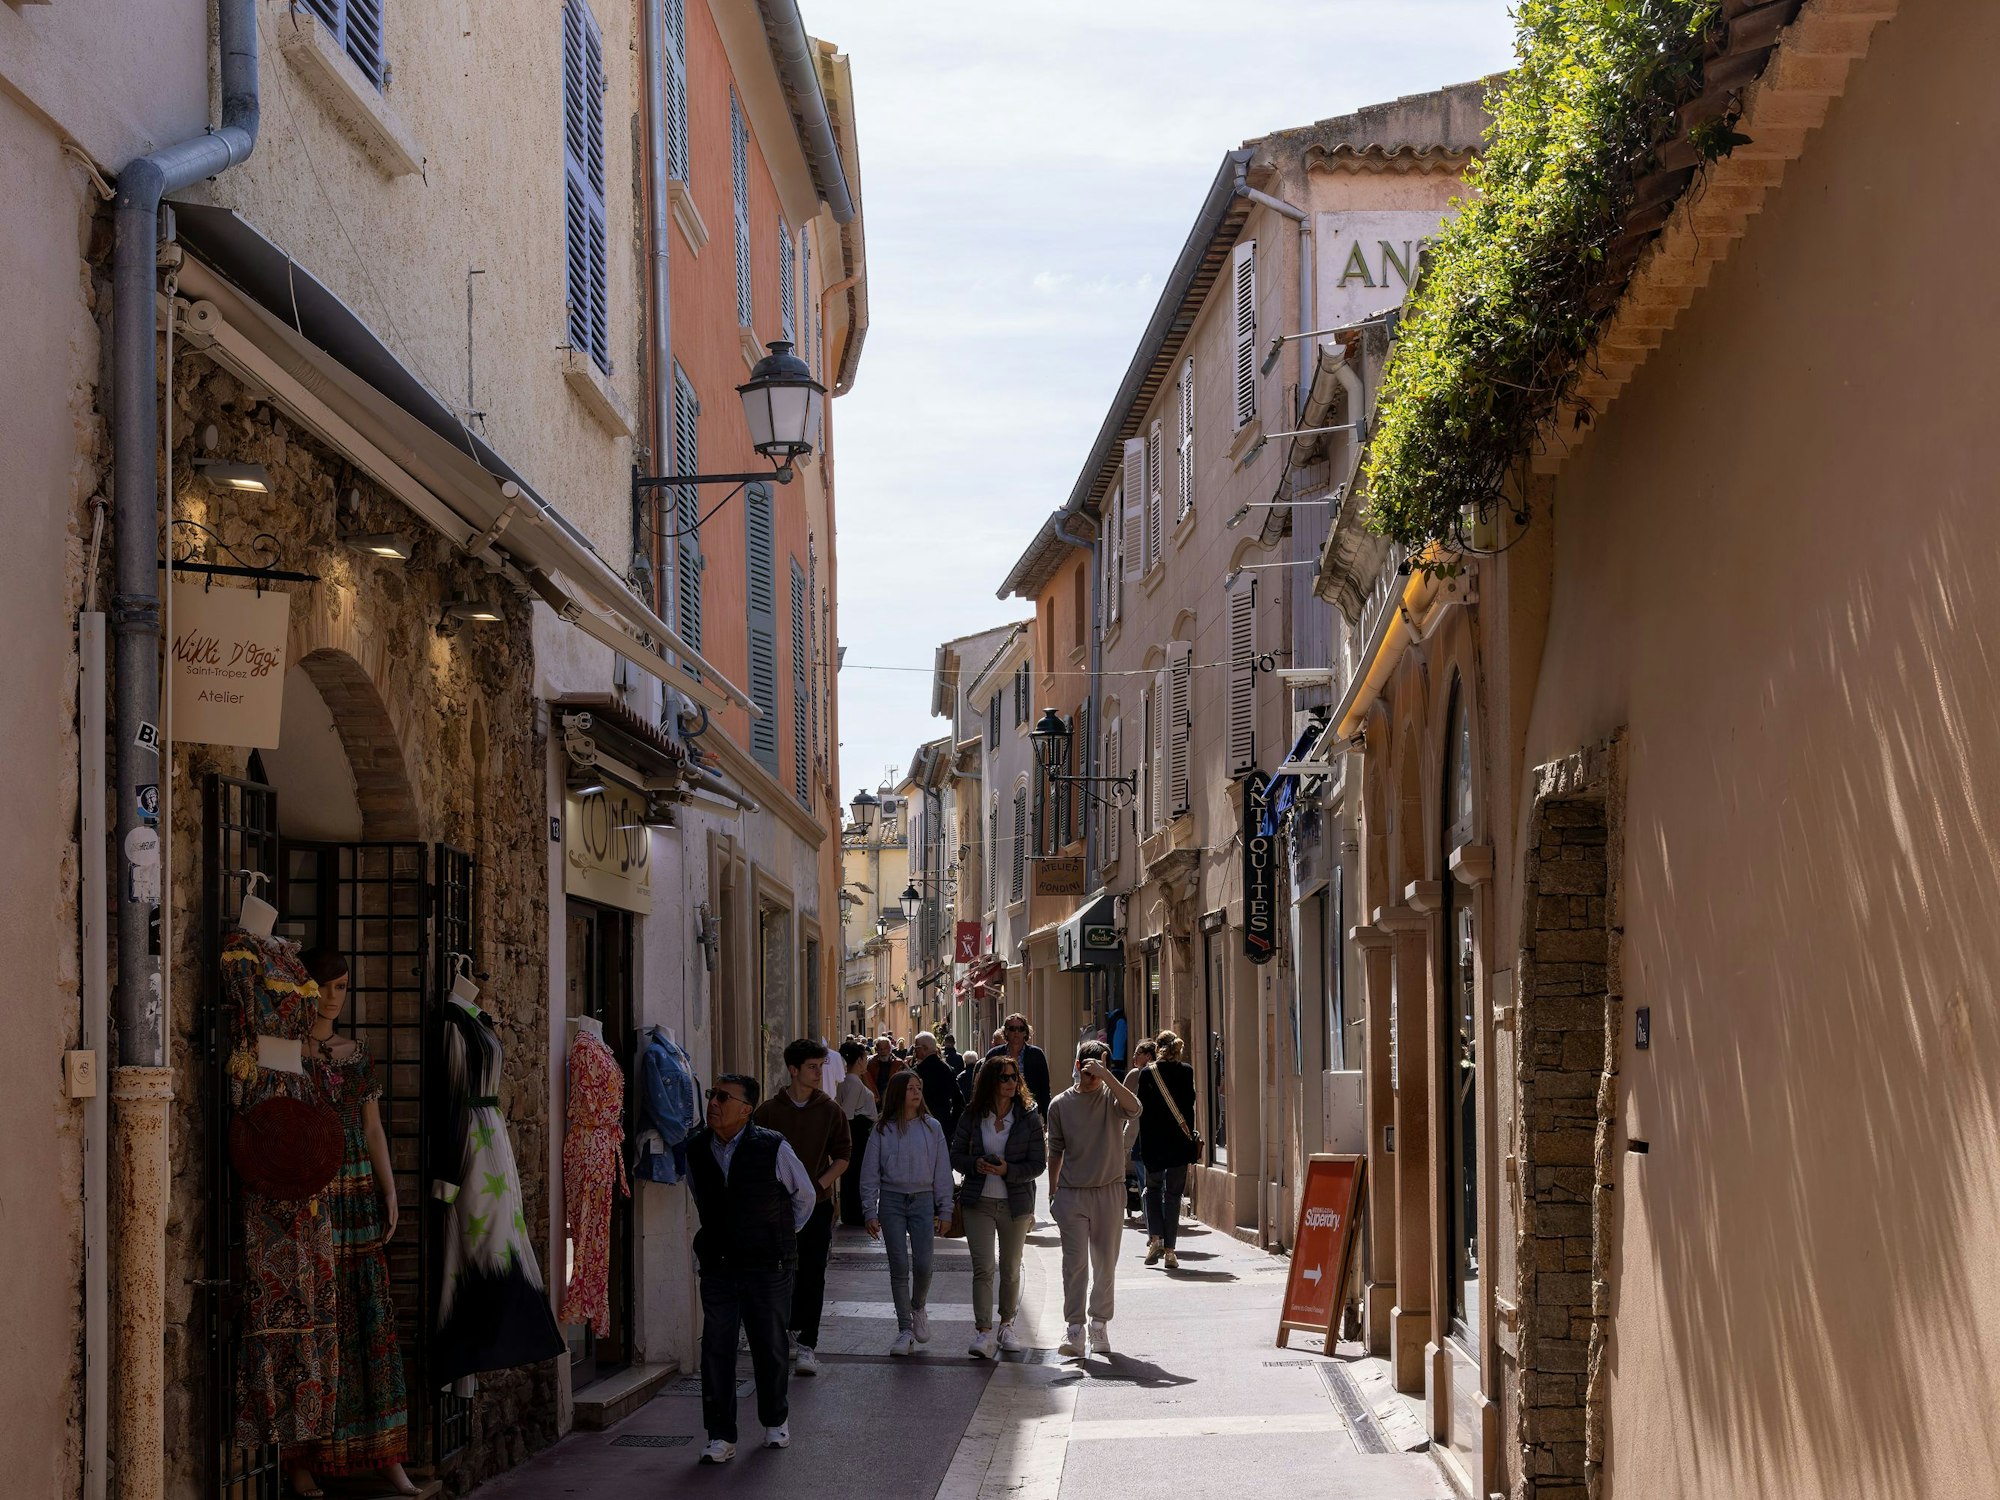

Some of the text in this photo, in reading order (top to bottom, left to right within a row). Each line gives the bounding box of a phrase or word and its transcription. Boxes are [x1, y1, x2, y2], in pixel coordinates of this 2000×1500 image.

[1336, 239, 1443, 288] AN
[186, 665, 248, 679] Saint-Tropez
[197, 690, 244, 705] Atelier
[1041, 863, 1079, 874] ATELIER
[1039, 880, 1080, 893] RONDINI
